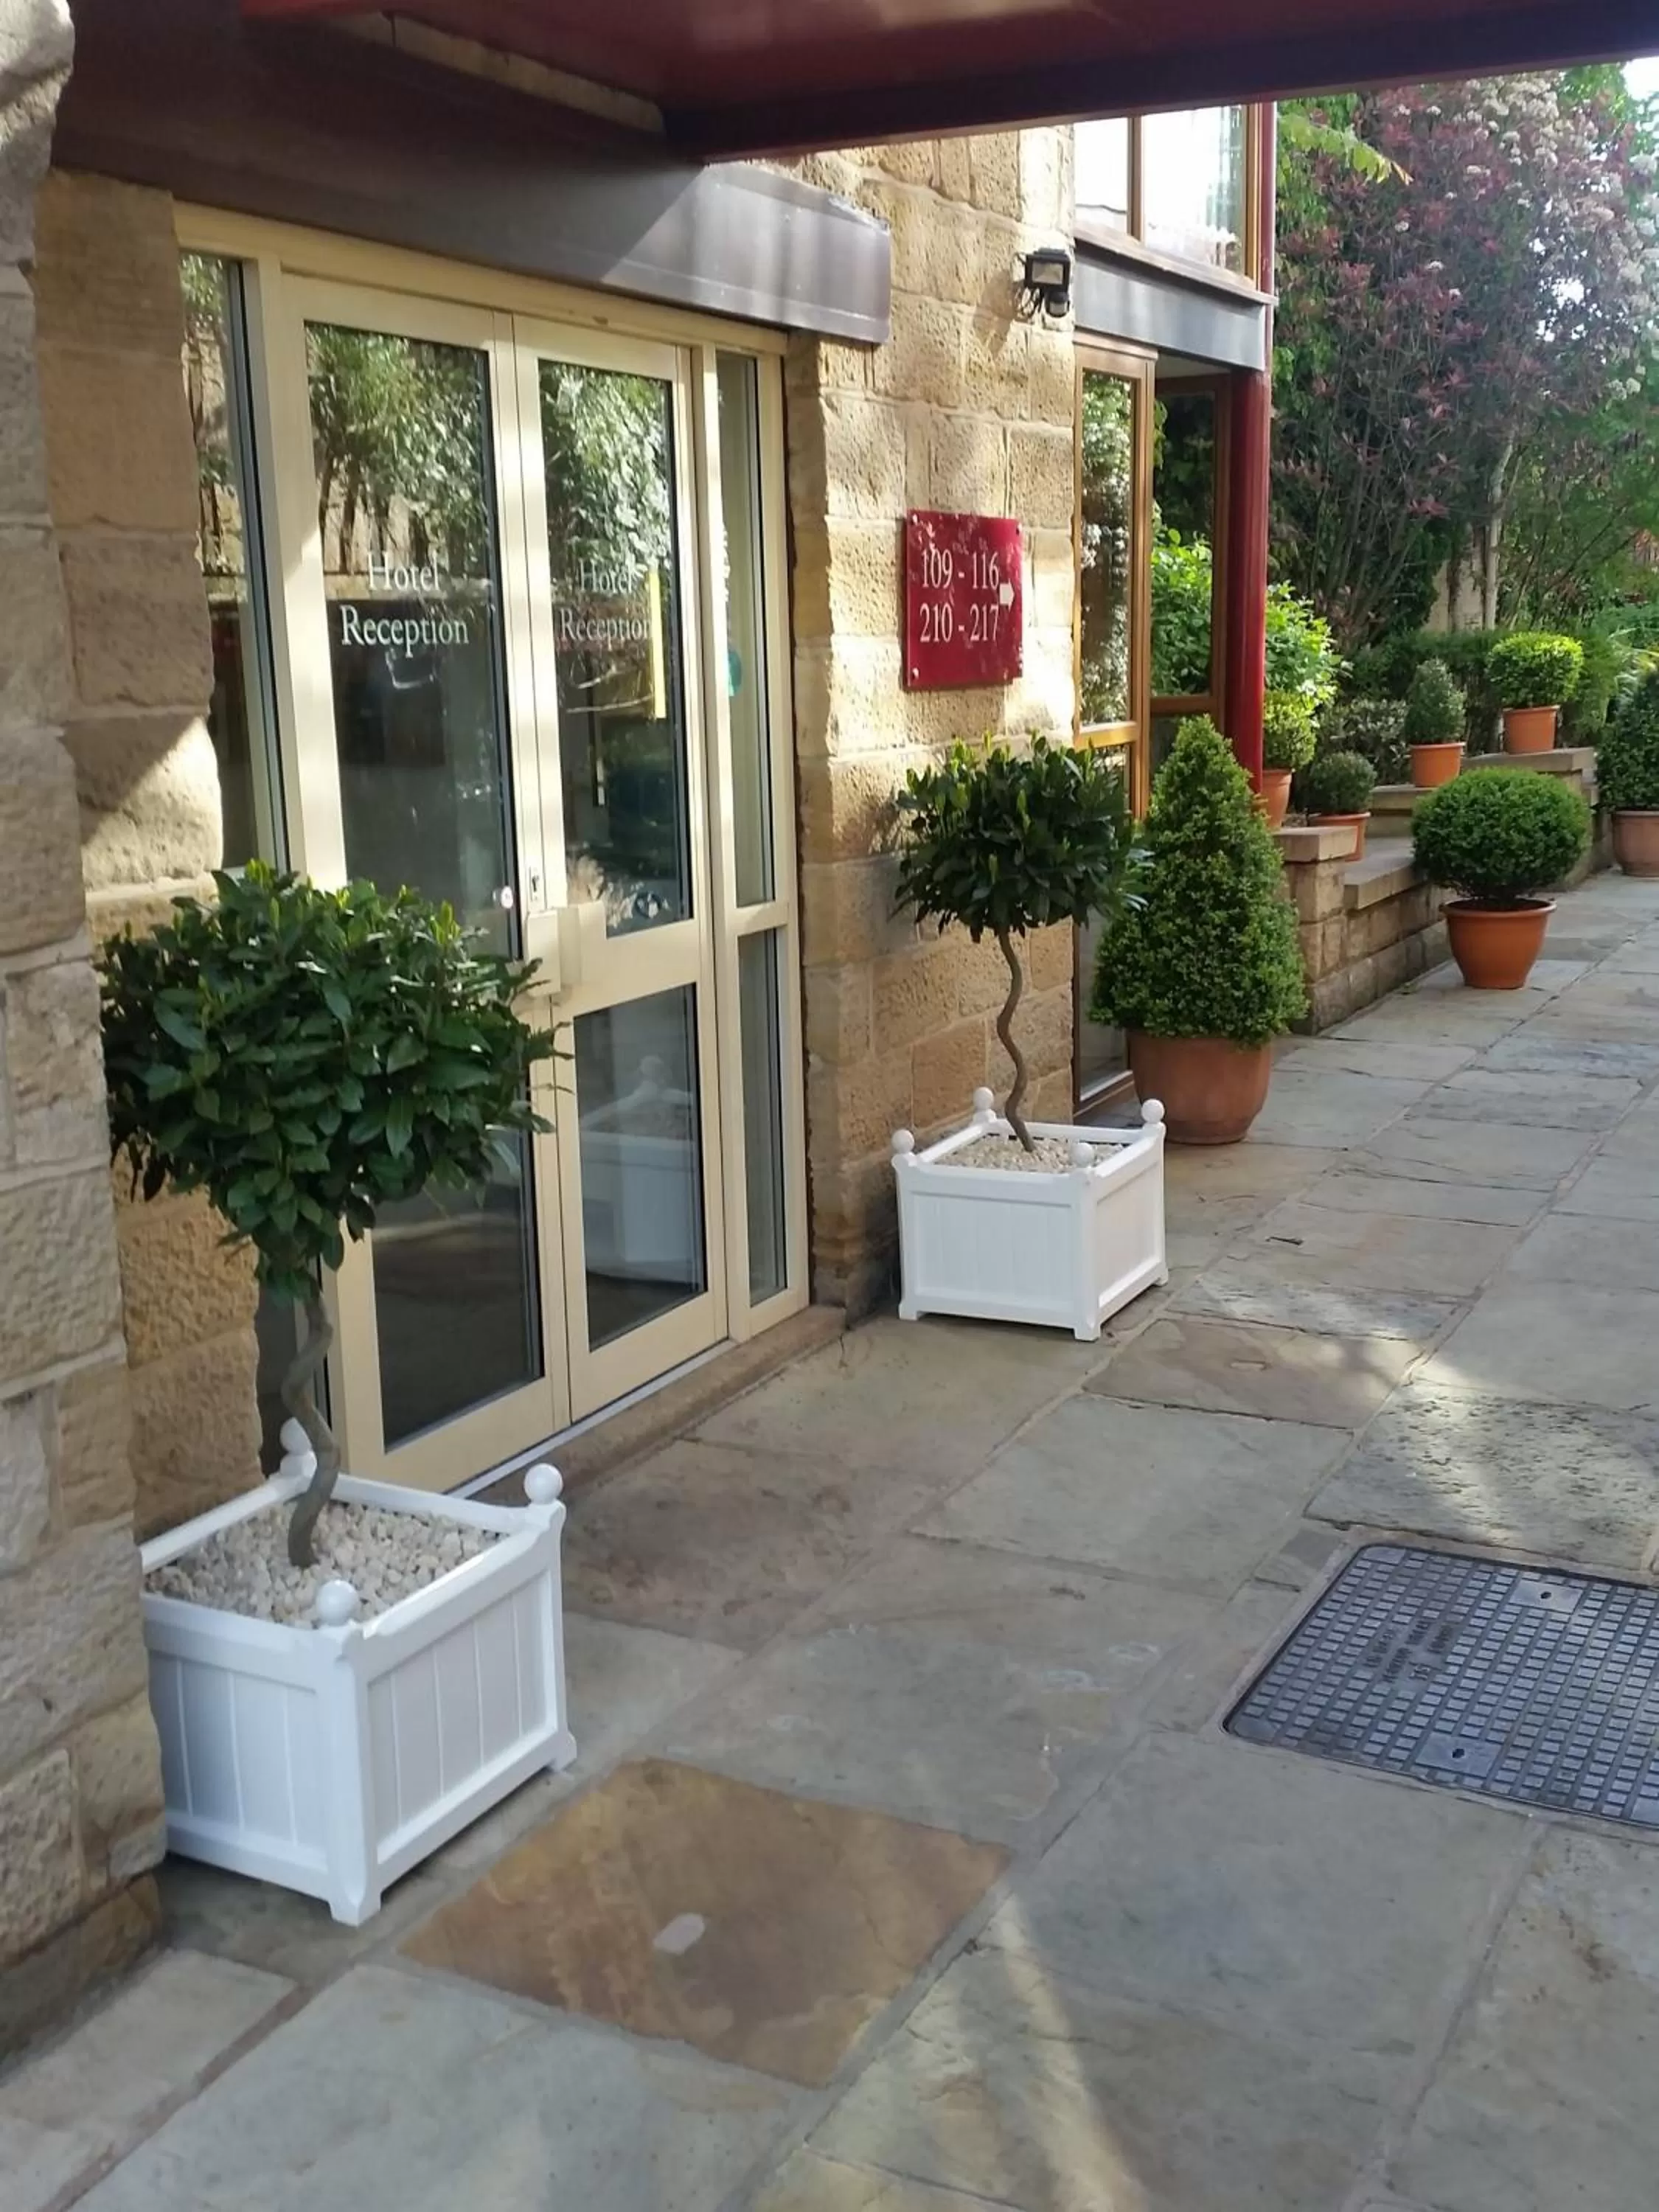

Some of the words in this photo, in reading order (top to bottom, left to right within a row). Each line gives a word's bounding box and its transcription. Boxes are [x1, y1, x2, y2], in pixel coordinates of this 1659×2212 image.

[369, 551, 441, 591] Hotel
[577, 557, 633, 594] Hotel
[922, 549, 953, 588] 109
[972, 552, 1000, 590] 116
[339, 605, 470, 658] Reception
[920, 603, 953, 642] 210
[970, 605, 1000, 642] 217
